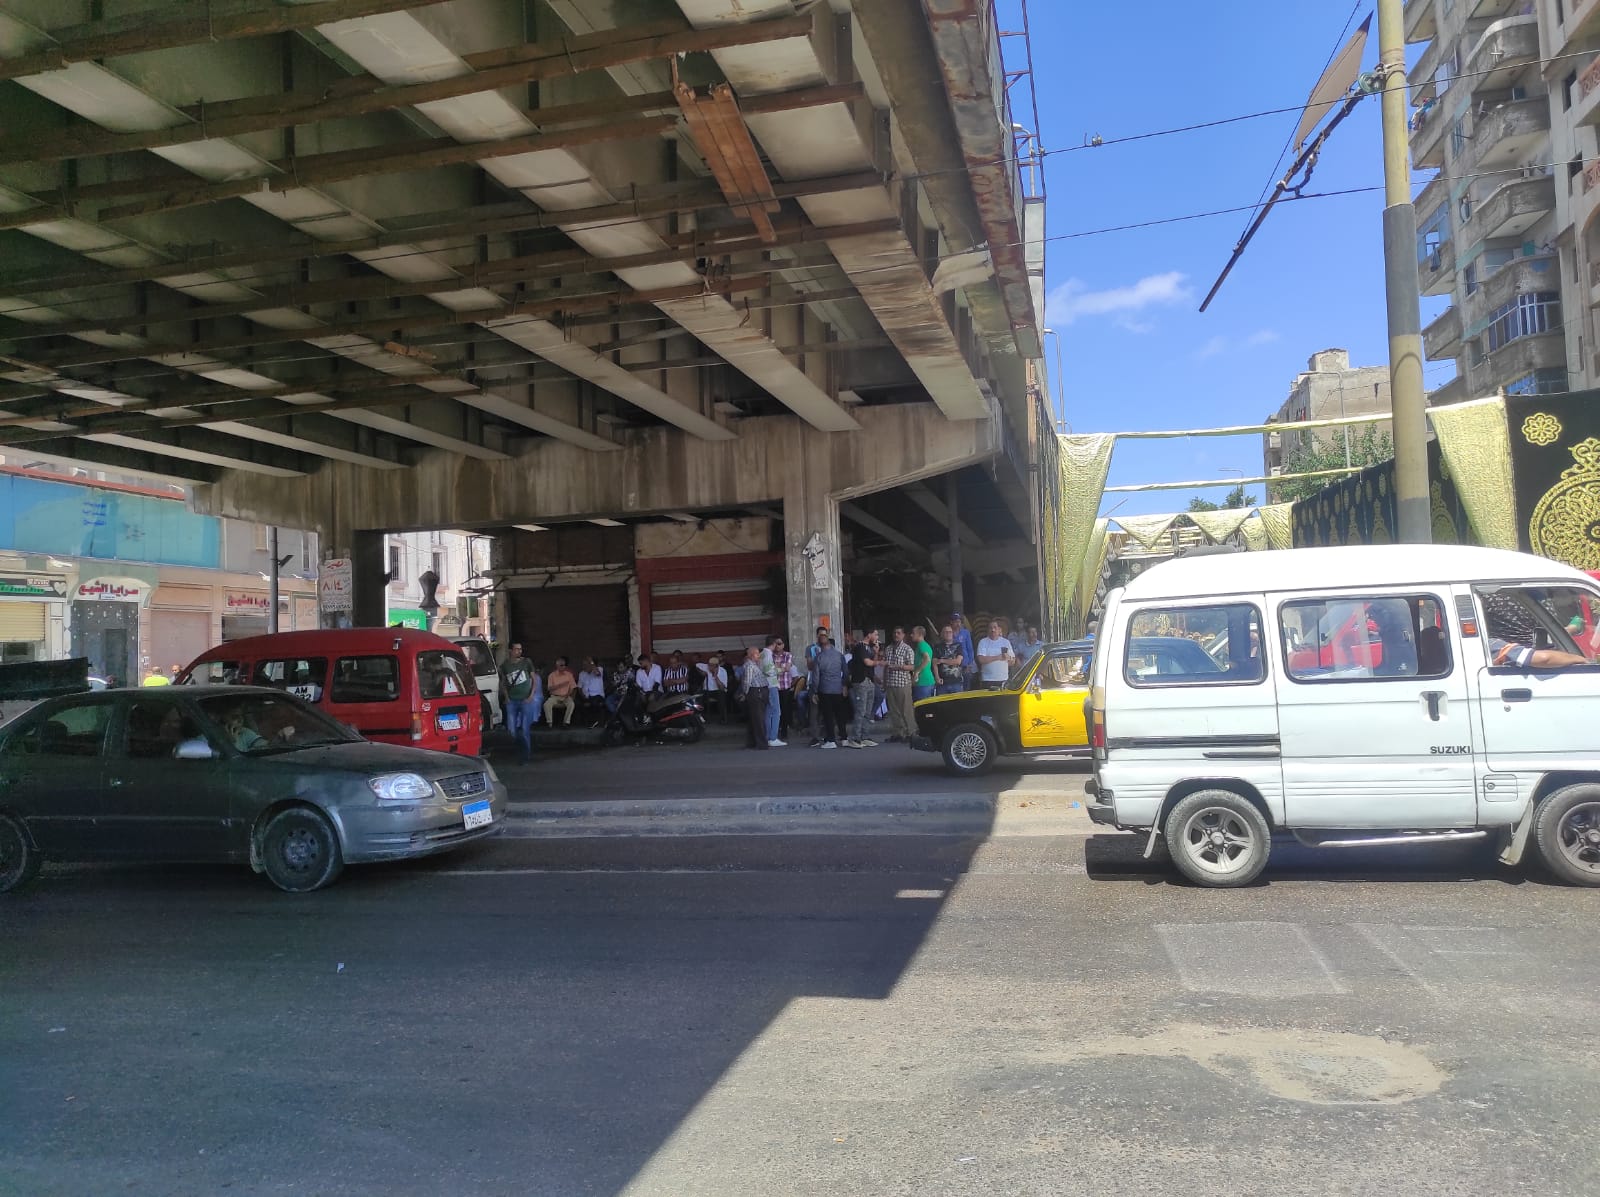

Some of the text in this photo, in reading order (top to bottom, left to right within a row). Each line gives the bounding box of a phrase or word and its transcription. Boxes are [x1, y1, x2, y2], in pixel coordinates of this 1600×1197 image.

[110, 584, 139, 597] سرايا
[254, 597, 270, 608] رايا
[295, 687, 308, 695] AM
[1430, 745, 1471, 754] SUZUKI
